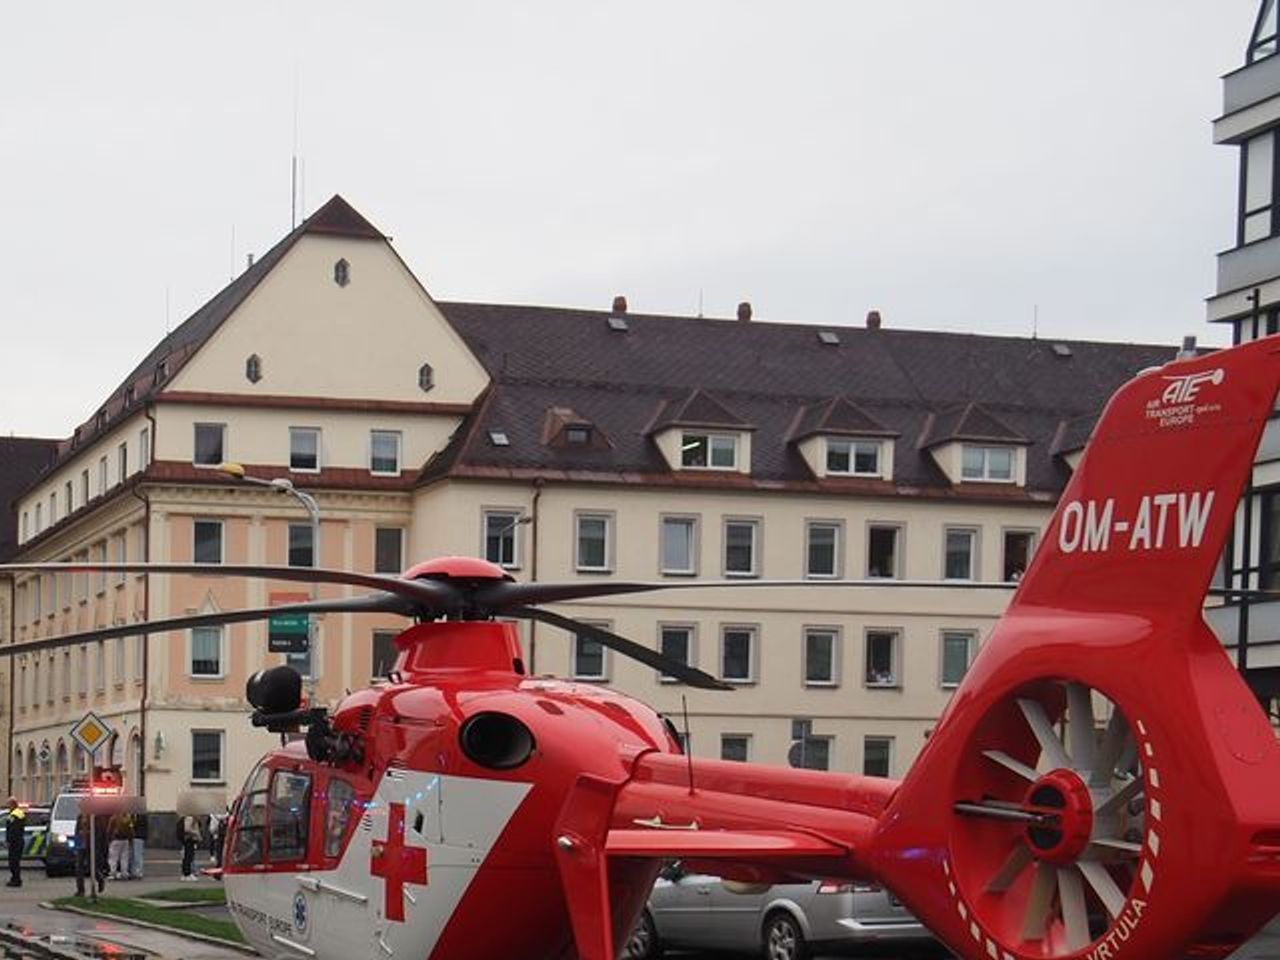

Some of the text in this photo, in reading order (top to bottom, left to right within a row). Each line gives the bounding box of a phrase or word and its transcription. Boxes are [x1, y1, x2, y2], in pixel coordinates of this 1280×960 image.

[1146, 404, 1195, 418] TRANSPORT
[1160, 414, 1193, 428] EUROPE
[1059, 490, 1215, 553] OM-ATW
